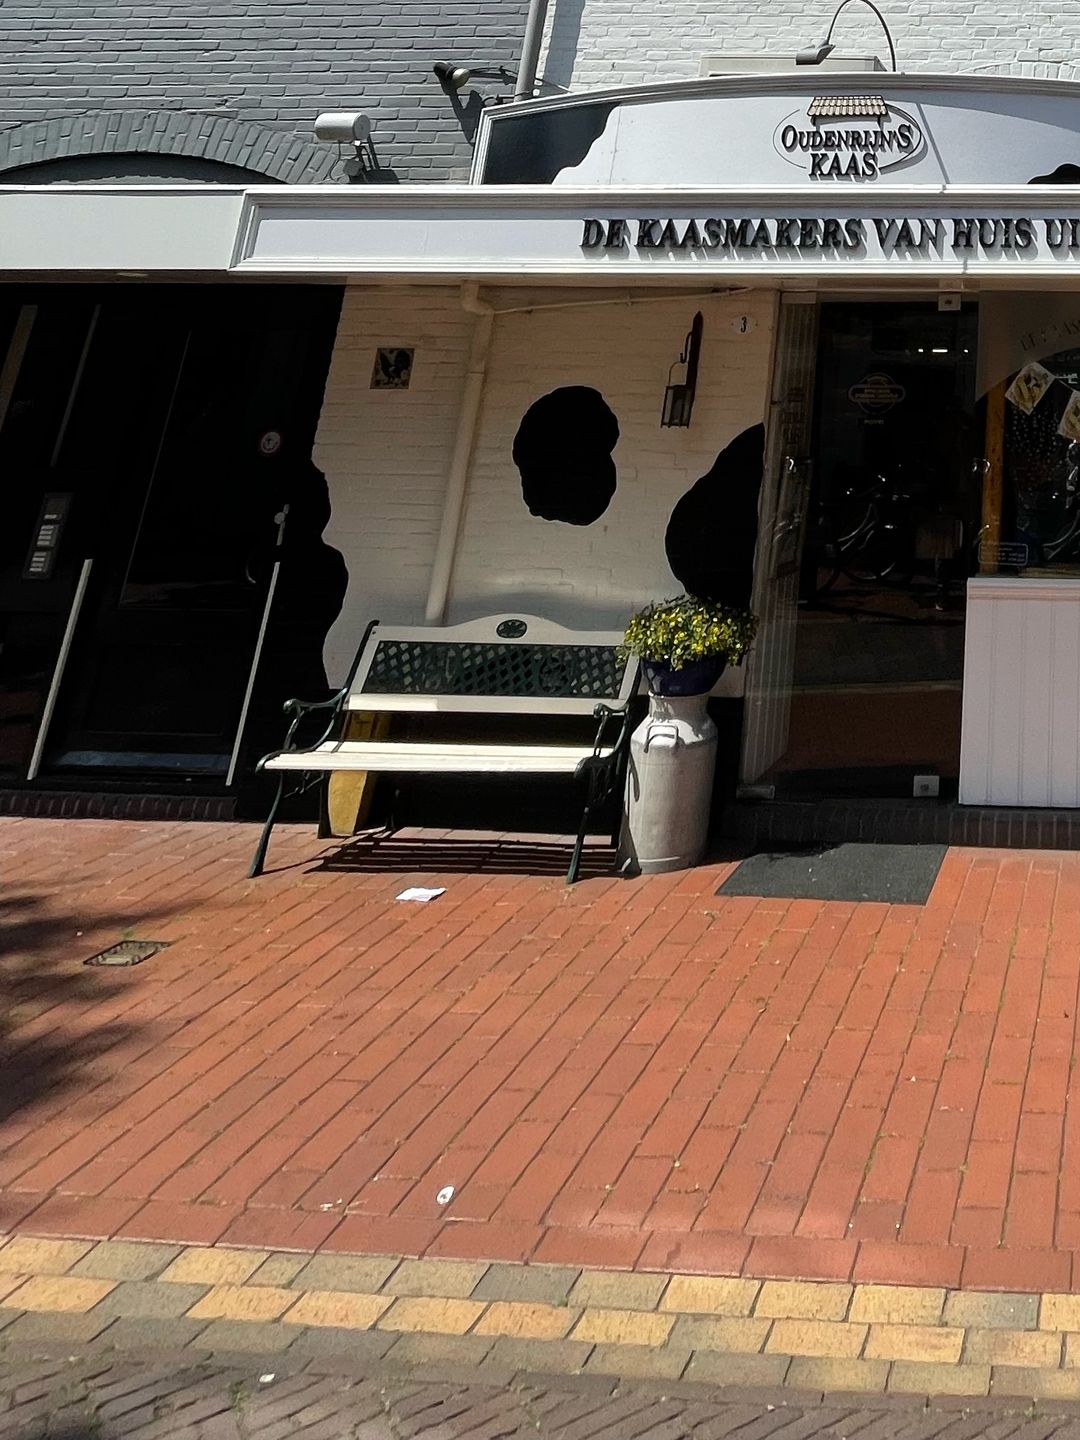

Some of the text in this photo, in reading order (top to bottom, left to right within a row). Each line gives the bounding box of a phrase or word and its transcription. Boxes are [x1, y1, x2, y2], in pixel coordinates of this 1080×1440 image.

[781, 124, 913, 149] OUDENRIJN'S
[808, 152, 877, 176] KAAS
[579, 218, 629, 249] DE
[634, 218, 864, 249] KAASMAKERS
[872, 218, 940, 249] VAN
[951, 218, 1034, 249] HUIS
